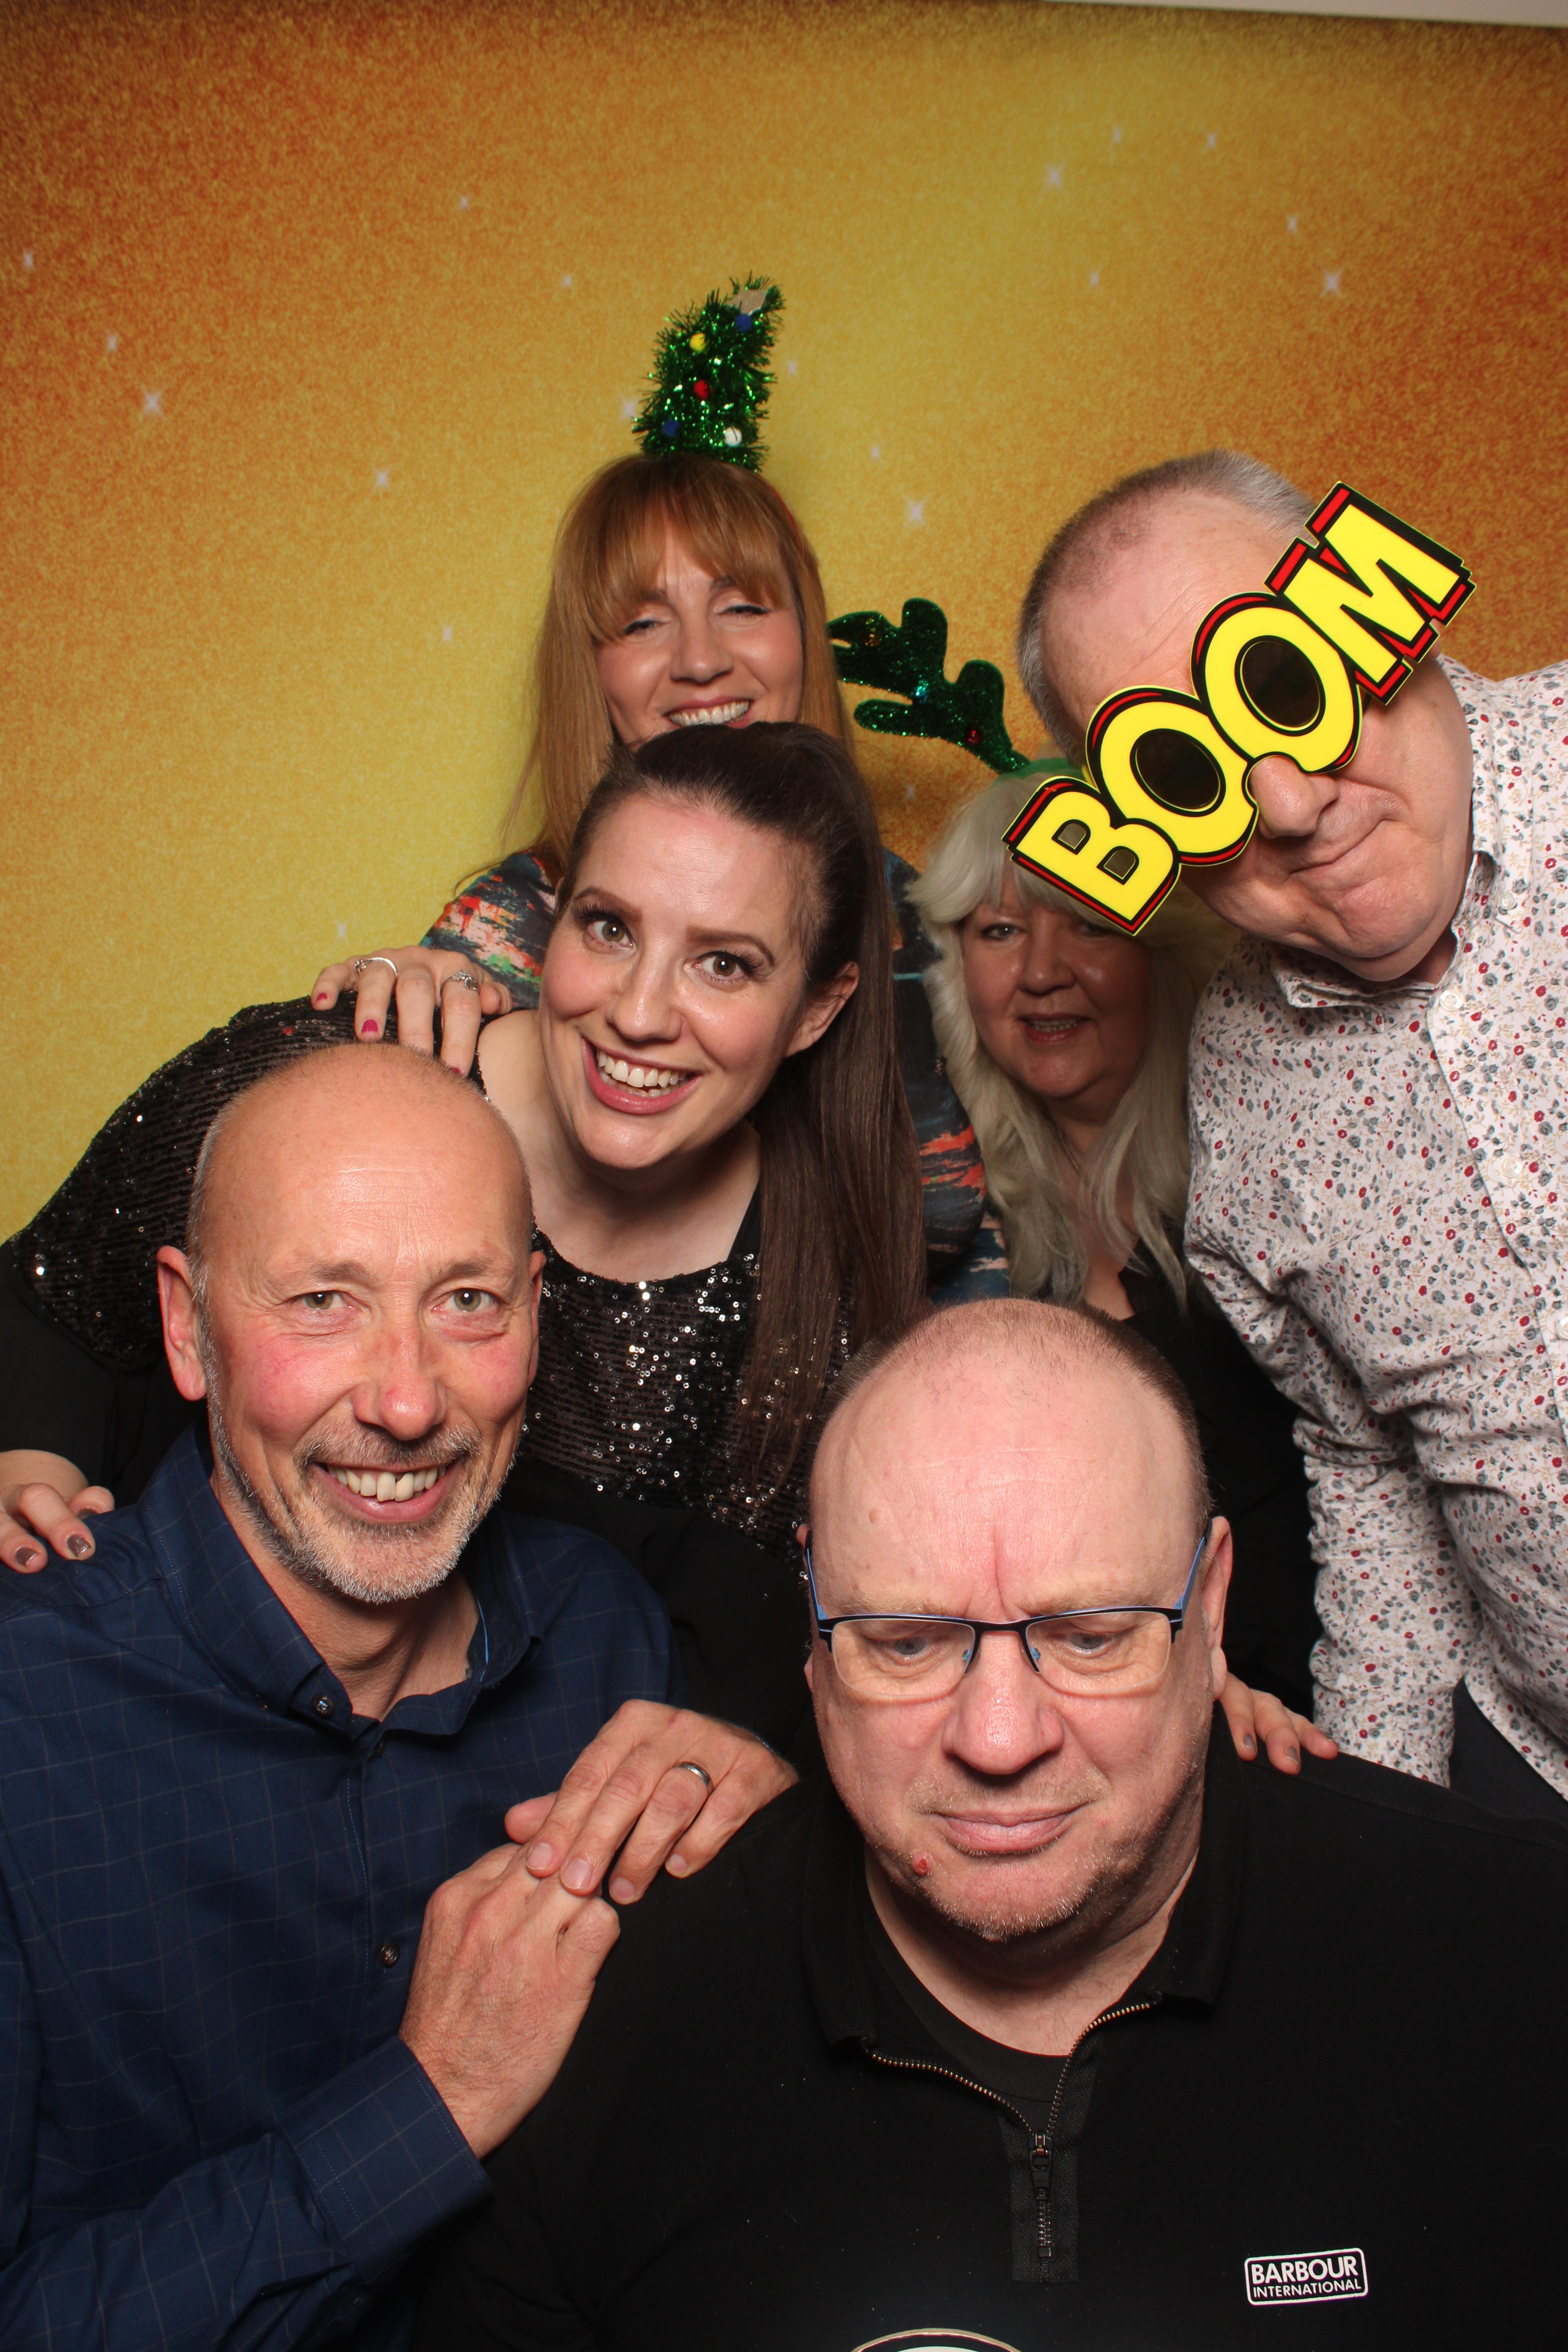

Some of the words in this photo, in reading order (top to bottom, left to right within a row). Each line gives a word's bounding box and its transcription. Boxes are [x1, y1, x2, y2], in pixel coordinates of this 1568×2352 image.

[1011, 496, 1466, 926] BOOM
[1251, 2256, 1359, 2285] BARBOUR
[1253, 2278, 1362, 2298] INTERNATIONAL
